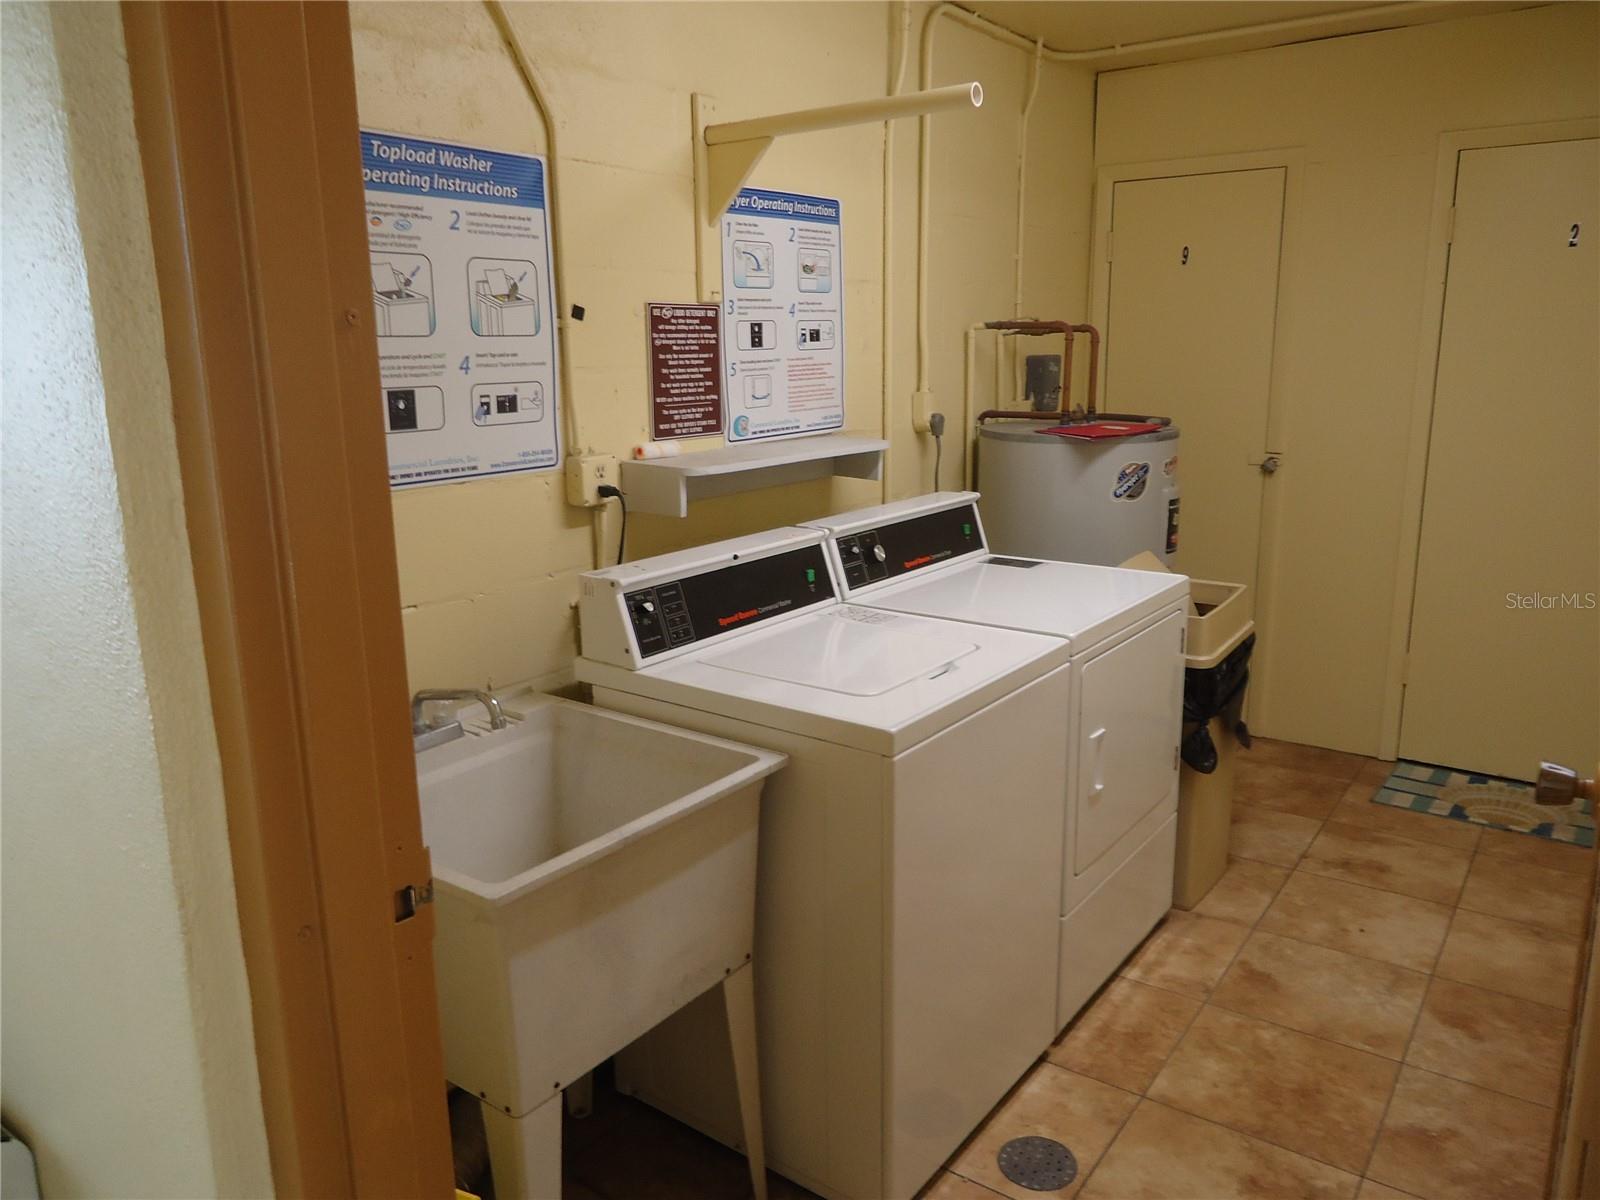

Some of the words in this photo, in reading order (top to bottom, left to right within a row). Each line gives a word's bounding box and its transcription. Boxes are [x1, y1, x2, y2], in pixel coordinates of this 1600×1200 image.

[371, 140, 436, 164] Topload
[439, 151, 492, 172] Washer
[362, 168, 430, 192] perating
[434, 174, 518, 198] Instructions
[751, 196, 793, 214] Operating
[794, 201, 836, 216] Instructions
[449, 210, 460, 231] 2
[788, 227, 796, 242] 2
[1568, 224, 1580, 248] 2
[728, 300, 734, 315] 3
[789, 304, 796, 318] 4
[460, 356, 470, 375] 4
[730, 362, 736, 376] 5
